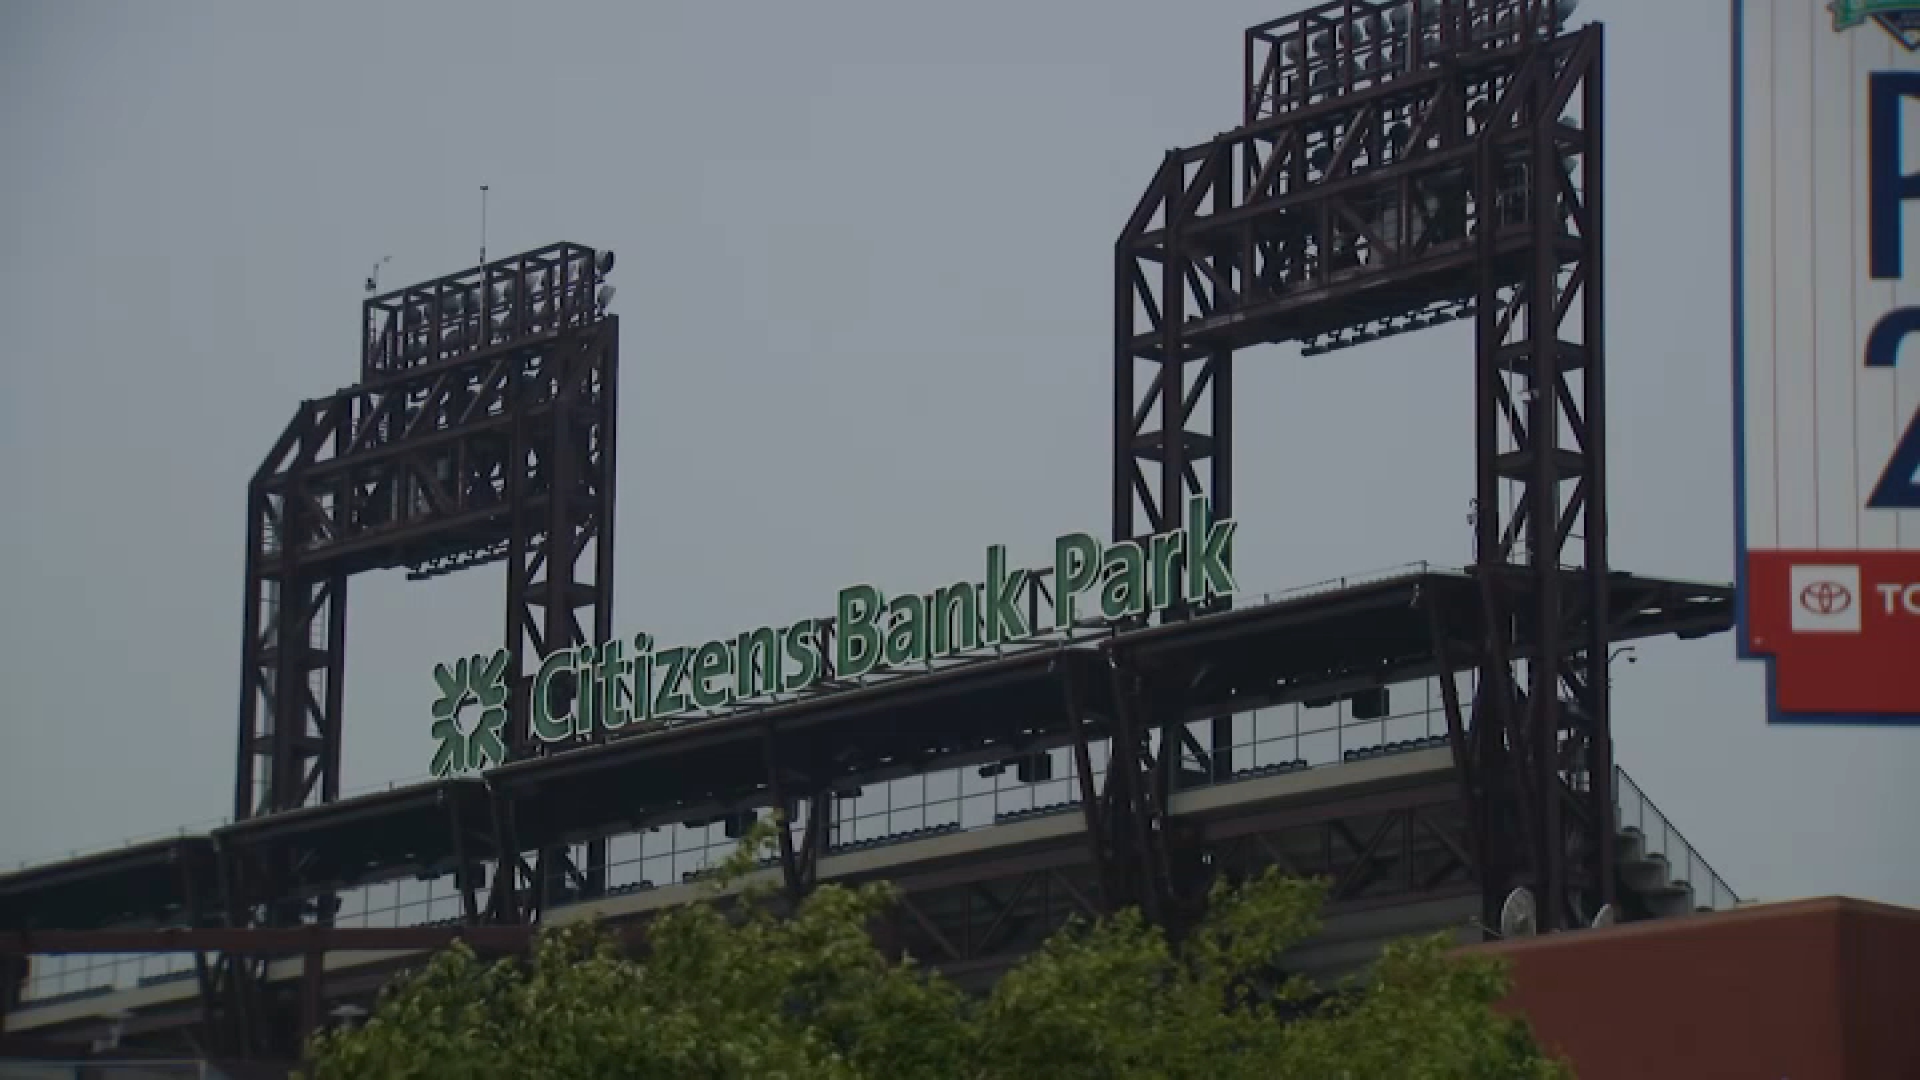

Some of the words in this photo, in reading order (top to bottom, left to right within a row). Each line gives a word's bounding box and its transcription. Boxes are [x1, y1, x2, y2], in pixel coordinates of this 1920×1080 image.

[533, 618, 822, 742] Citizens
[836, 543, 1031, 679] Bank
[1055, 494, 1238, 630] Park
